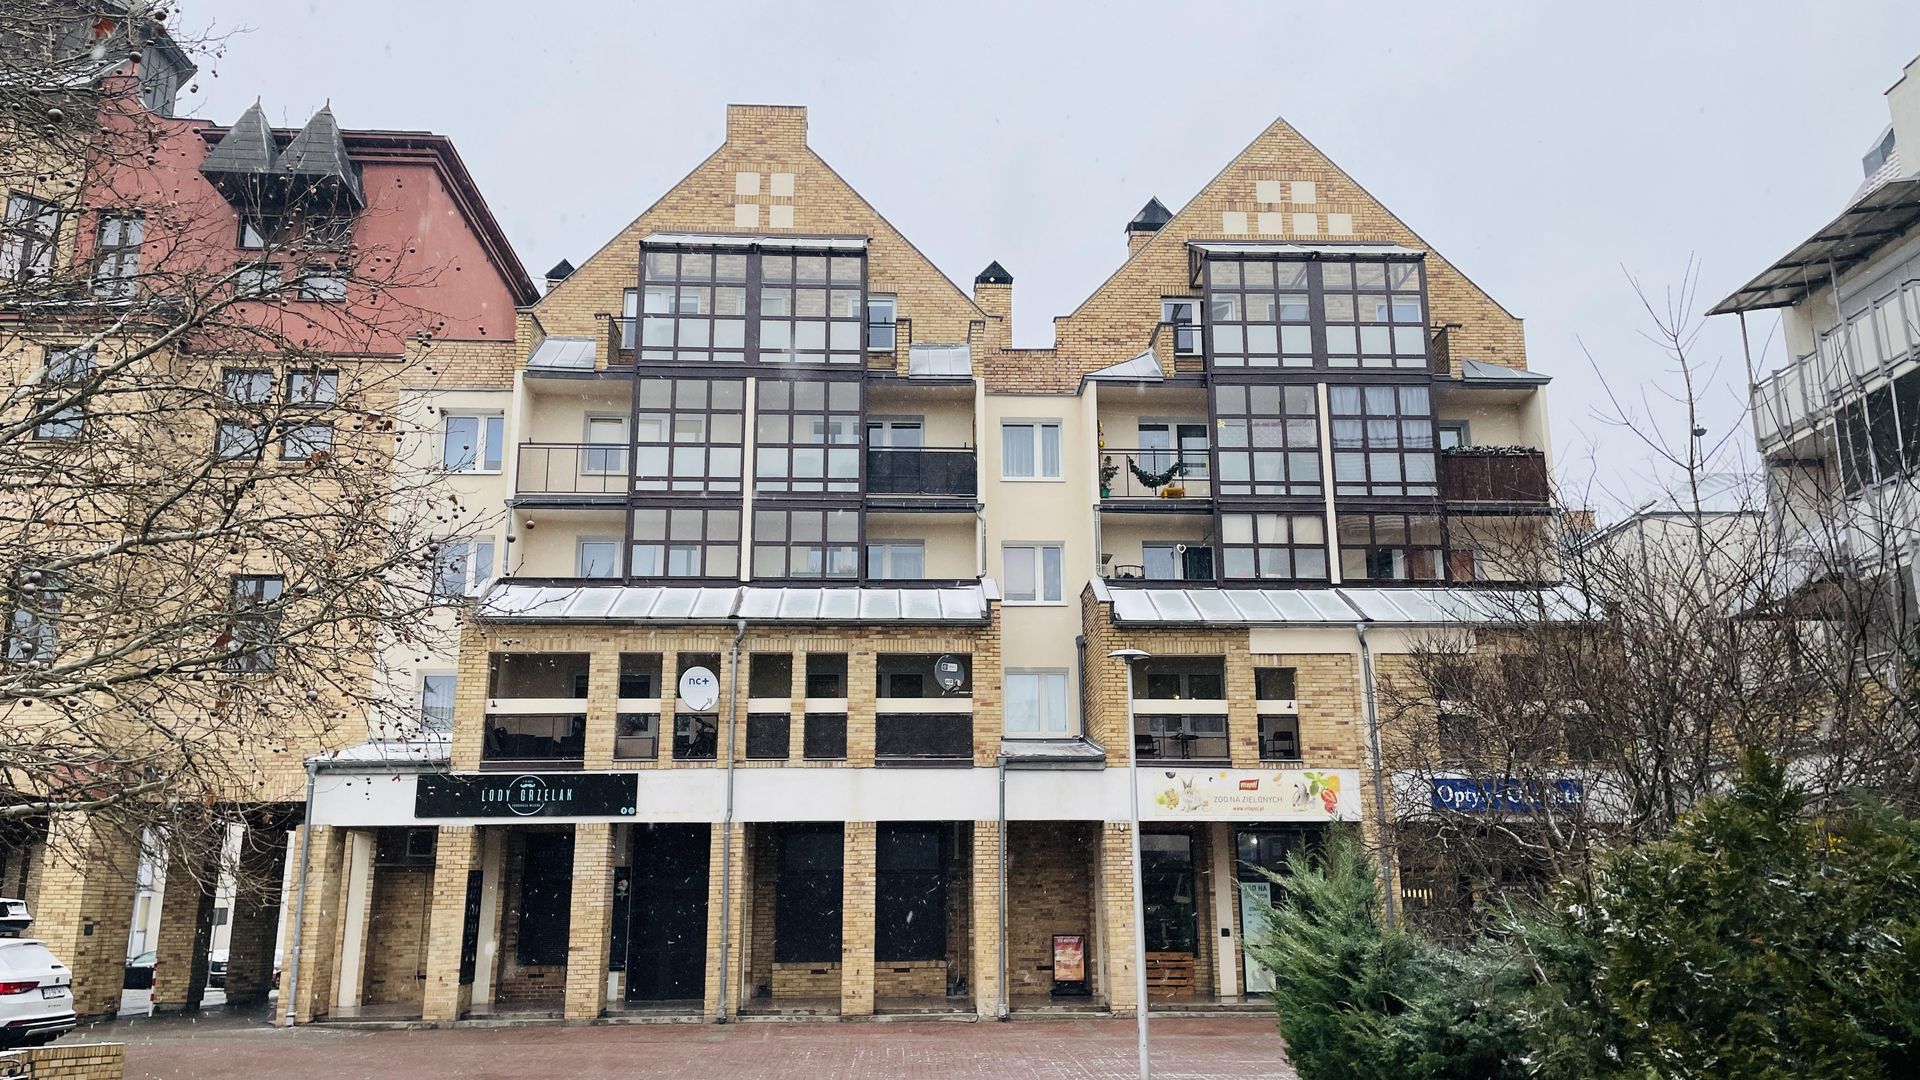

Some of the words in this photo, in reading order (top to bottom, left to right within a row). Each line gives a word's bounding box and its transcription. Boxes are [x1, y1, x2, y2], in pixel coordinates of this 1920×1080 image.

[689, 677, 709, 685] nc+
[481, 789, 511, 802] LODY
[520, 788, 573, 801] GRZELAK
